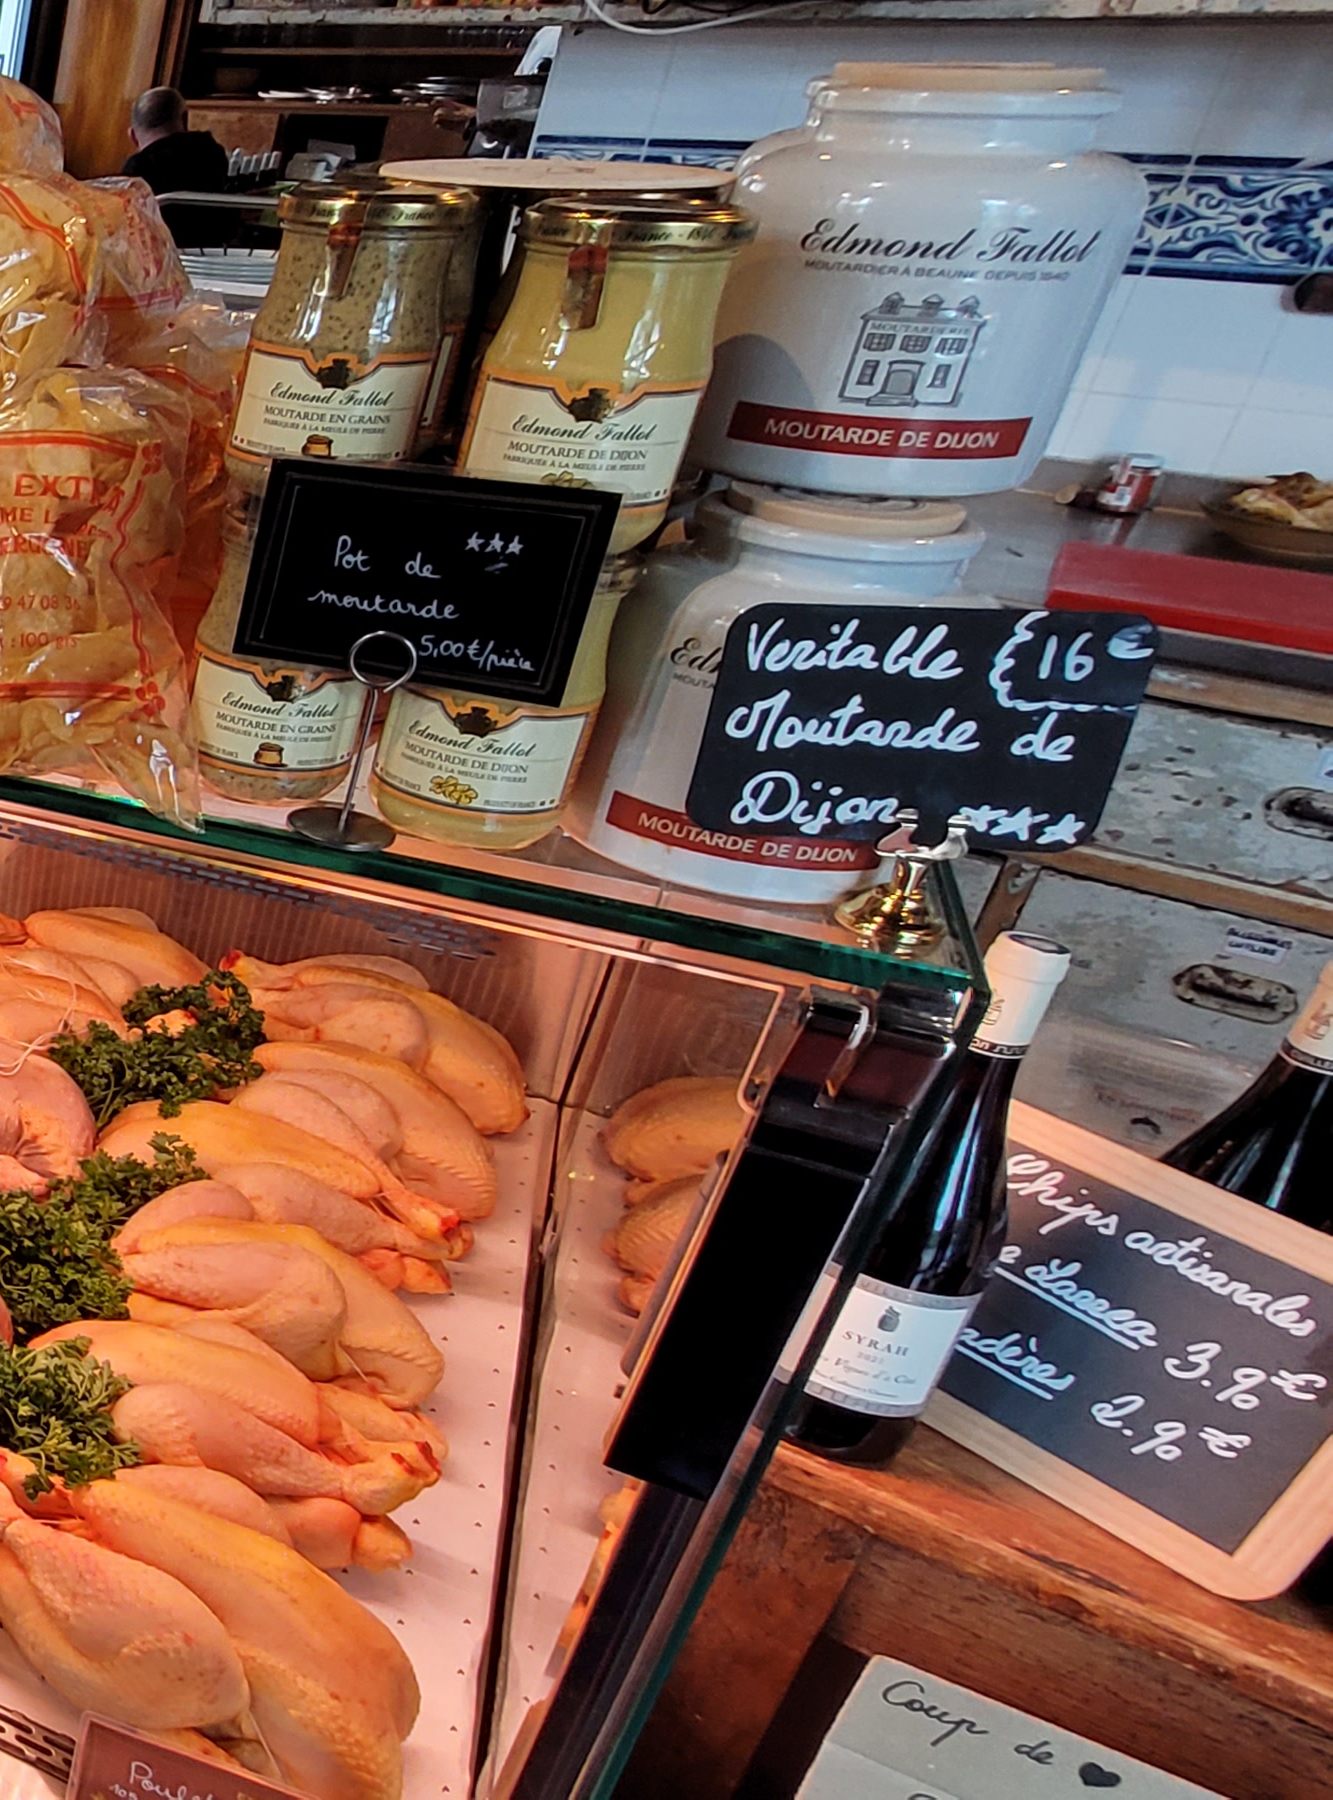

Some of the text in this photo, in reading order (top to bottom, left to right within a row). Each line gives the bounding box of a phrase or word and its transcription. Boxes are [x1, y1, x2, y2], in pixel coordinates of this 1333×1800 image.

[800, 218, 1103, 264] Edmond Fallot
[804, 259, 898, 276] MOUTARDIER
[900, 262, 912, 276] À
[914, 266, 978, 280] BEAUNE
[984, 269, 1038, 281] DEPUIS
[870, 321, 971, 336] MOUTARDERIE
[269, 381, 396, 408] Edmond Fallot
[264, 404, 391, 426] MOUTARDE EN GRAINS
[511, 414, 659, 442] Edmond Fallot
[764, 417, 1001, 449] MOUTARDE DE DIJON
[507, 440, 649, 461] MOUTARDE DE DIJON
[13, 473, 126, 516] EXTRA
[334, 535, 441, 578] Pot de
[17, 597, 37, 612] 47
[41, 596, 59, 612] 08
[307, 590, 460, 619] moutarde
[20, 632, 78, 651] 100 grs
[222, 691, 340, 718] Edmond Fallot
[216, 711, 337, 735] MOUTARDE EN GRAINS
[725, 690, 1077, 763] Moutarde de
[408, 719, 536, 758] Edmond Fallot
[405, 741, 529, 774] MOUTARDE DE DIJON
[730, 771, 900, 838] Dijon
[638, 812, 859, 863] MOUTARDE DE DIJON
[1123, 1228, 1317, 1337] artisanales
[841, 1330, 910, 1357] SYRAH
[881, 1680, 1056, 1766] Coup de
